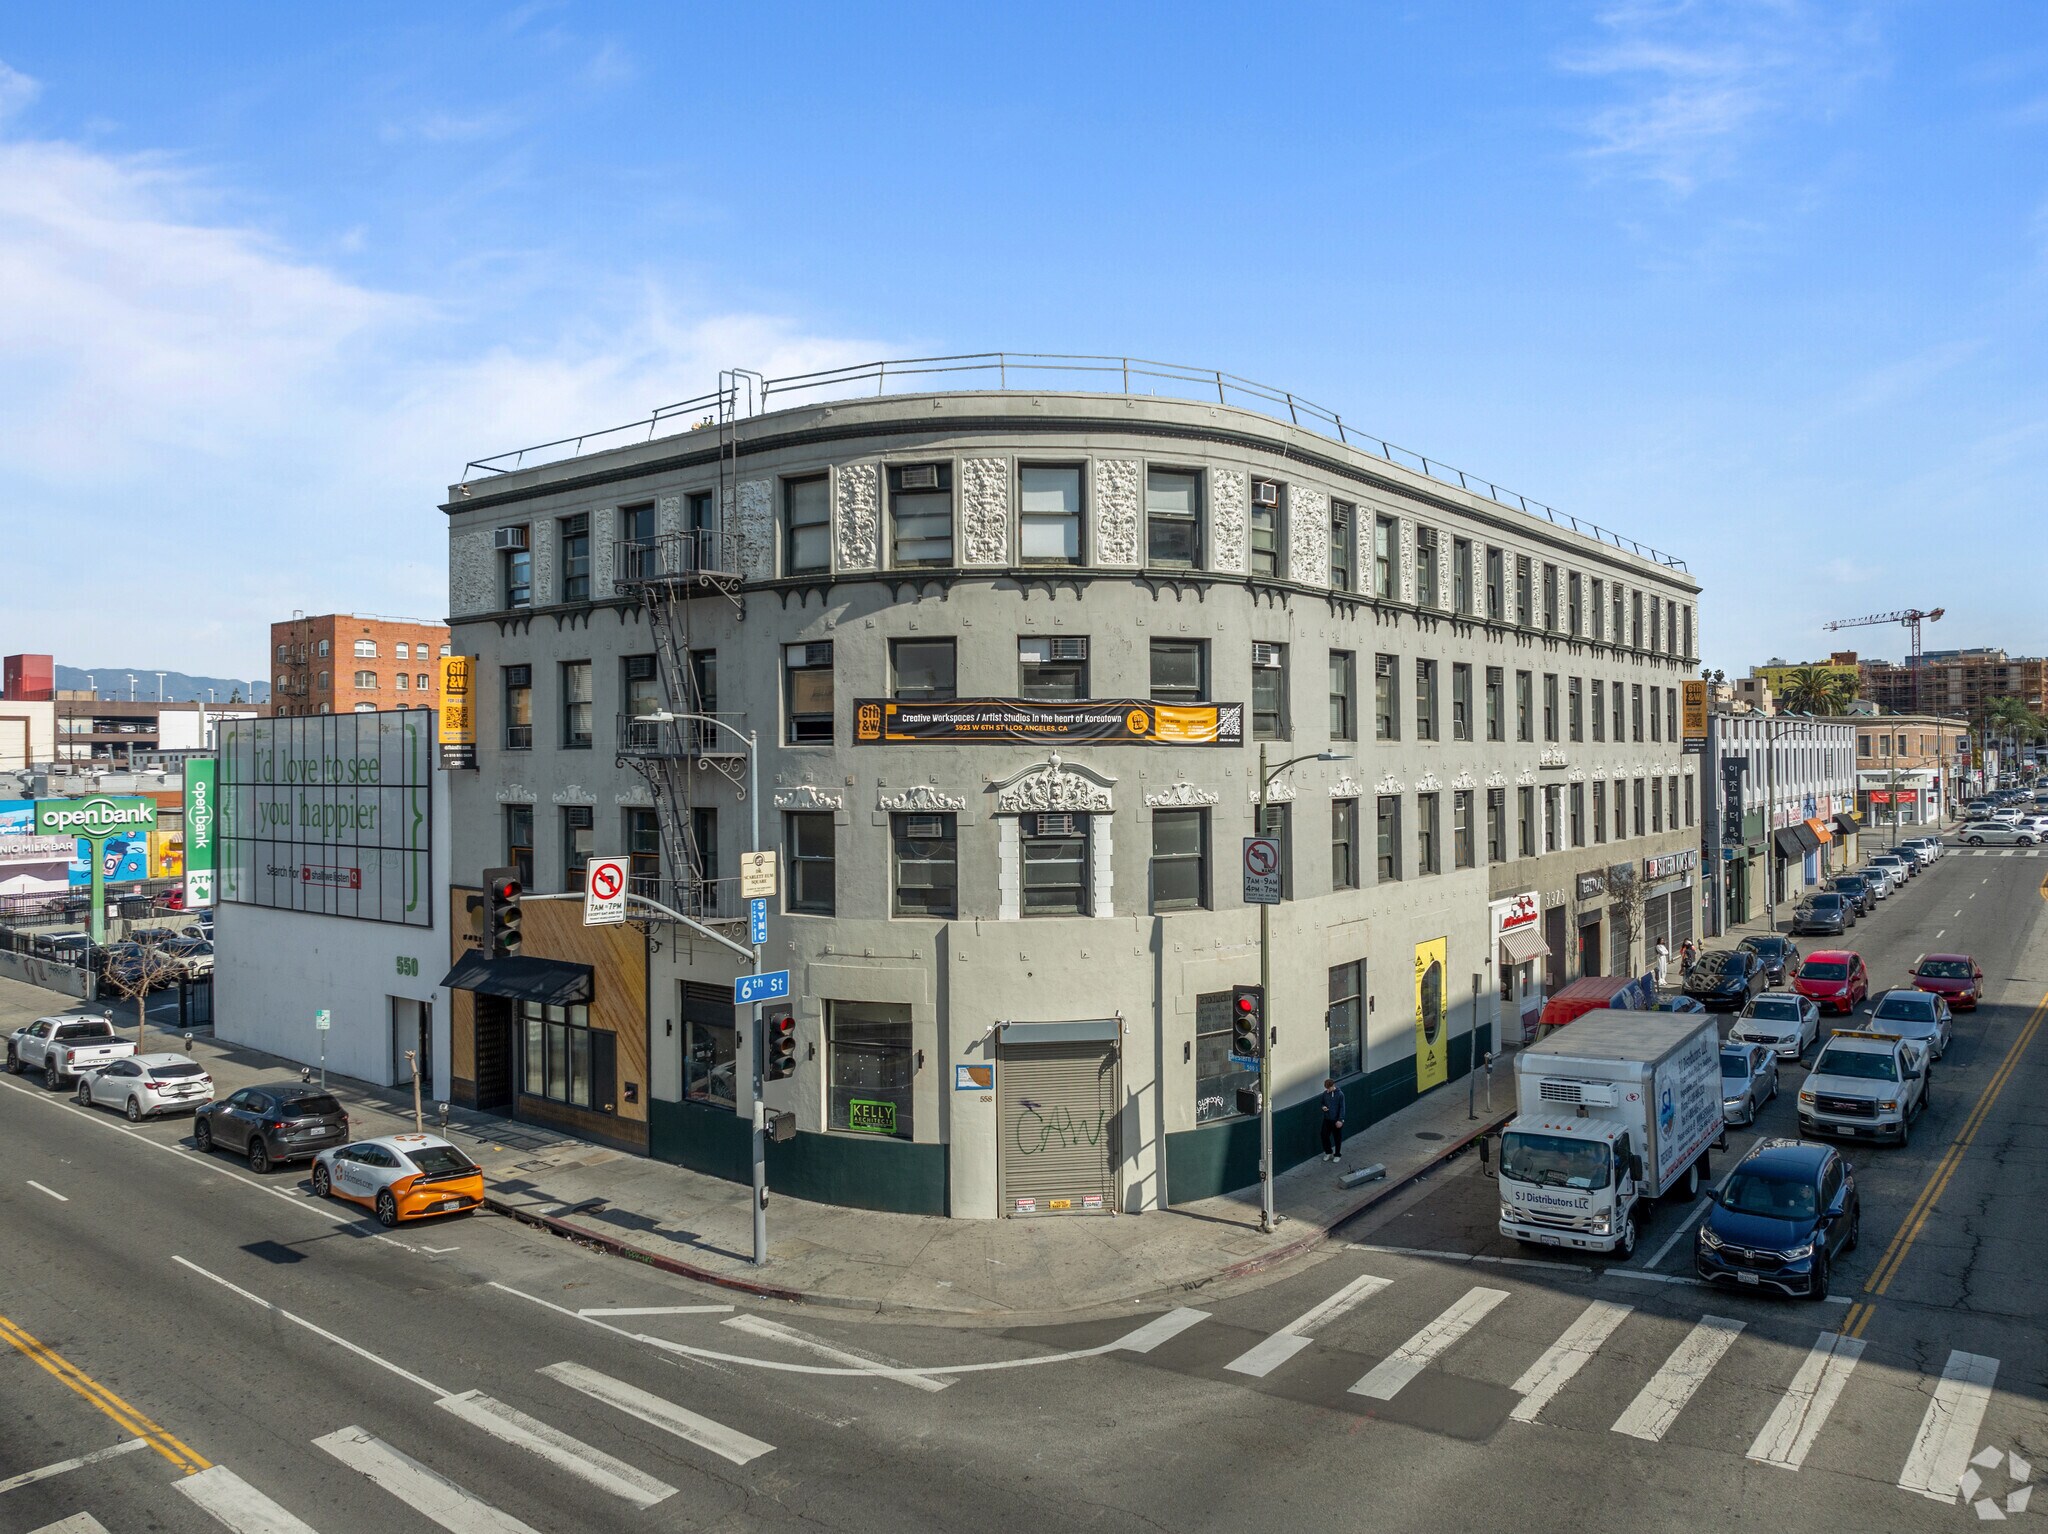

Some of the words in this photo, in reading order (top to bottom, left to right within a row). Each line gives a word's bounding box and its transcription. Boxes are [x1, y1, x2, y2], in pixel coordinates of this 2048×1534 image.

[862, 707, 880, 719] 6th
[902, 714, 931, 723] Creative
[932, 714, 975, 724] Workspaces
[982, 713, 1002, 722] Artist
[1003, 713, 1031, 723] Studios
[1041, 714, 1053, 723] the
[1054, 714, 1075, 723] heart
[1075, 714, 1083, 723] of
[1084, 714, 1122, 723] Koreatown
[862, 720, 879, 732] &W
[255, 748, 273, 783] I'd
[281, 750, 318, 783] love
[325, 754, 344, 784] to
[347, 757, 380, 784] see
[259, 801, 291, 833] you
[298, 793, 378, 839] happier
[22, 843, 49, 853] MILK
[51, 841, 74, 852] BAR
[266, 864, 287, 878] Search
[289, 866, 300, 879] for
[189, 875, 215, 885] ATM
[1246, 876, 1260, 884] 7AM
[1263, 877, 1278, 885] 9AM
[1545, 888, 1566, 908] 3923
[590, 904, 604, 912] 7AM
[608, 902, 622, 910] 7PM
[757, 901, 766, 940] SYNC
[396, 956, 419, 977] 550
[741, 978, 764, 999] 6th
[770, 977, 783, 992] St
[853, 1104, 893, 1119] KELLY
[854, 1116, 893, 1125] ARCHITECTS
[344, 1170, 374, 1191] Homes.com
[1515, 1191, 1520, 1200] S
[1521, 1192, 1526, 1201] J
[1527, 1192, 1573, 1208] Distributors
[1574, 1200, 1589, 1210] LLC
